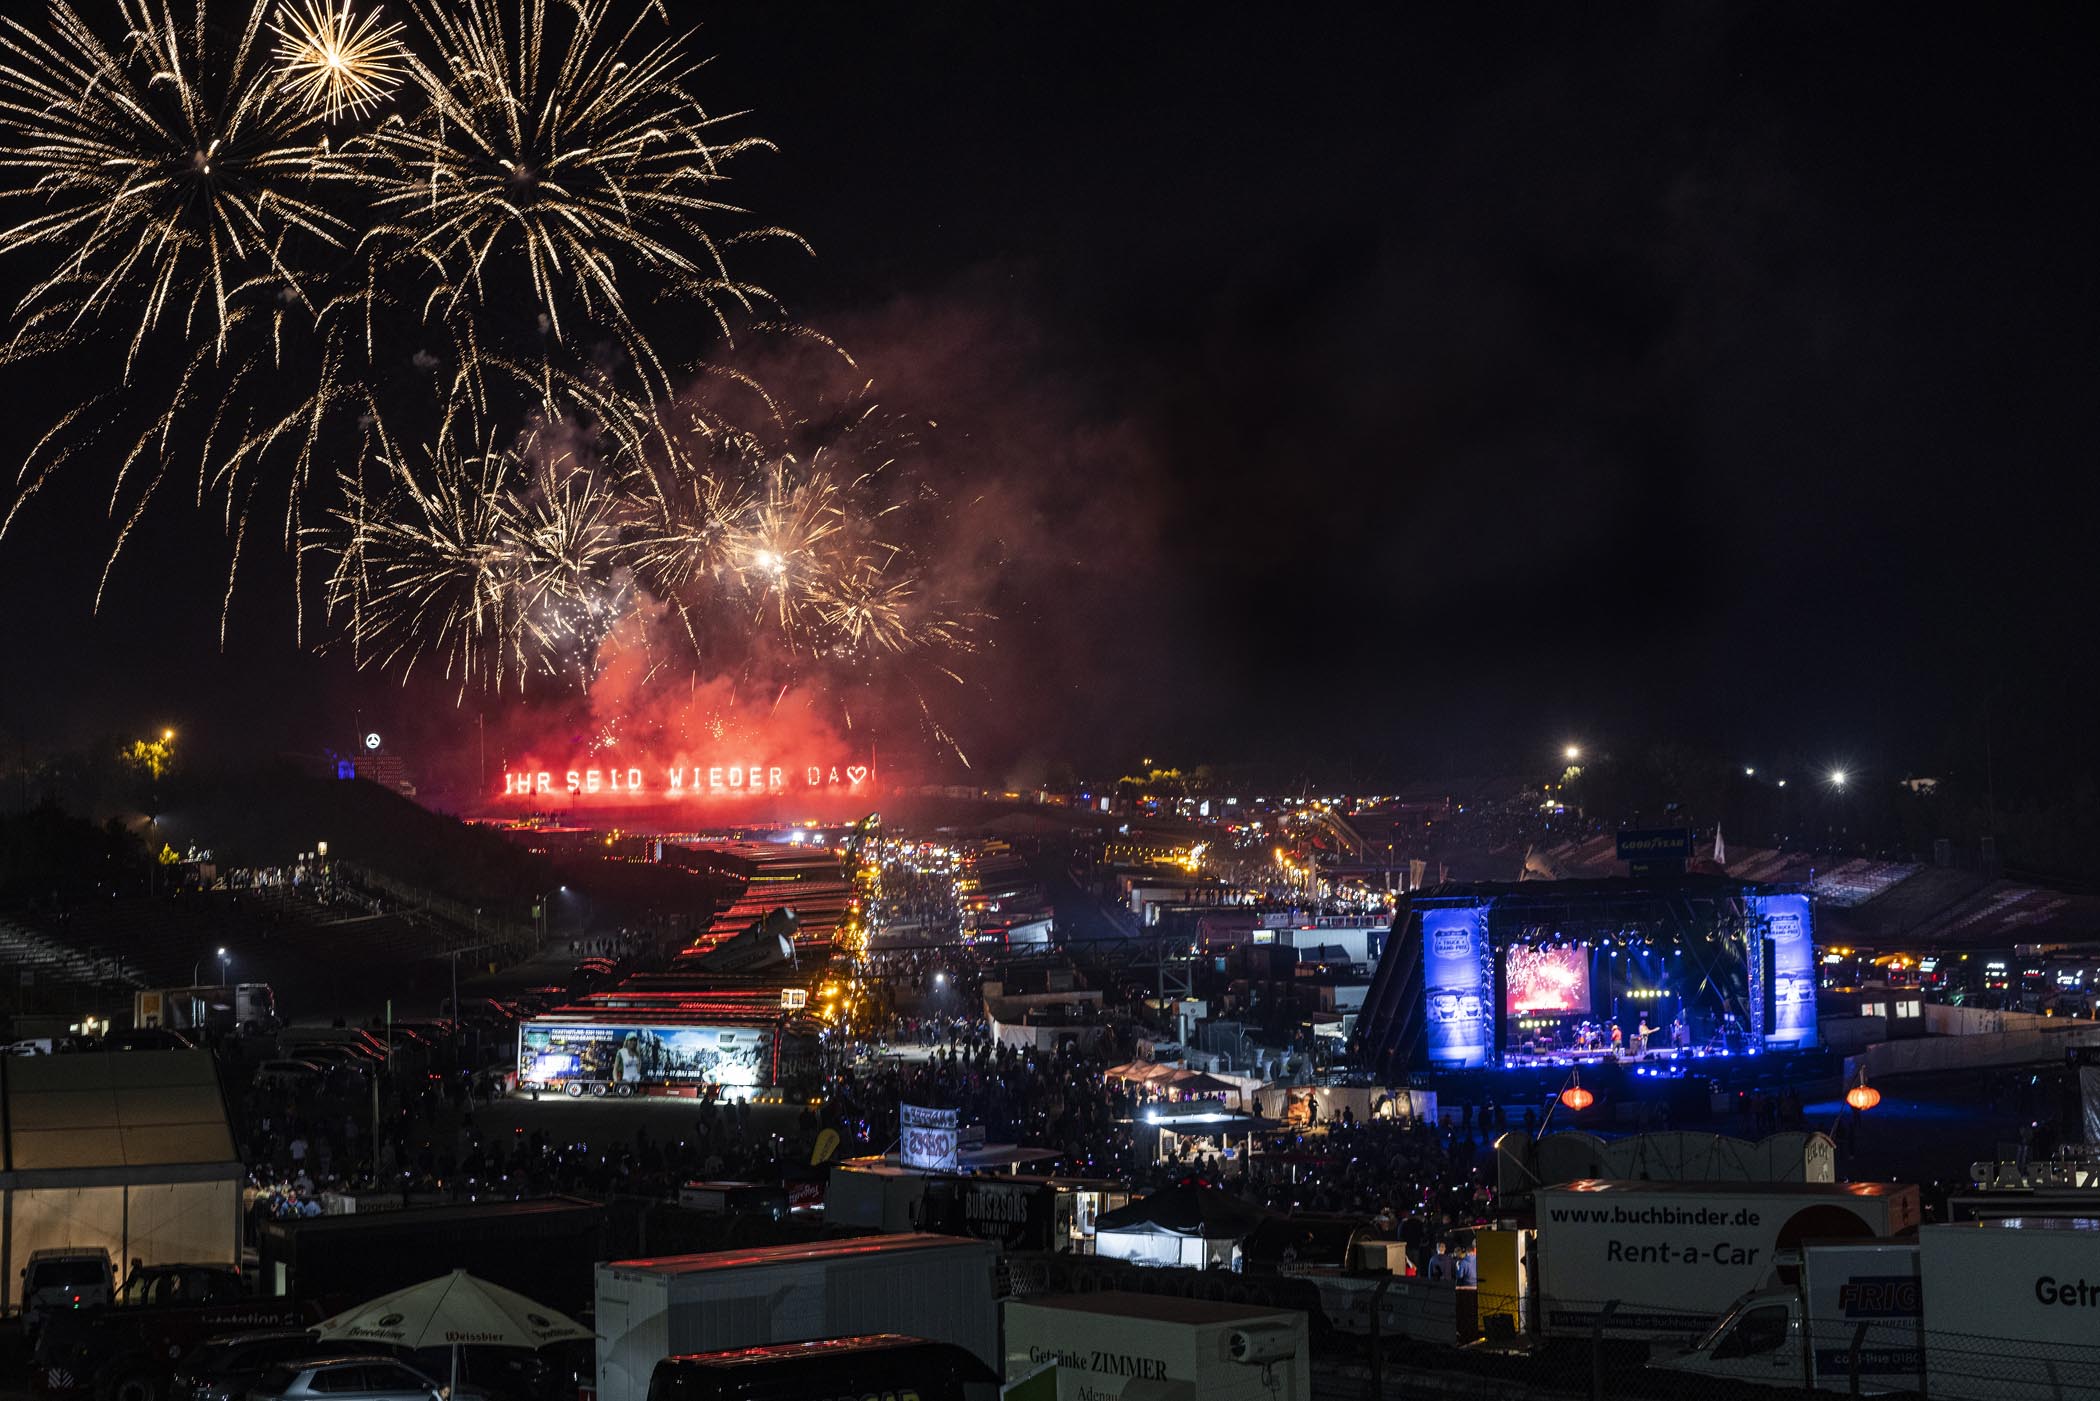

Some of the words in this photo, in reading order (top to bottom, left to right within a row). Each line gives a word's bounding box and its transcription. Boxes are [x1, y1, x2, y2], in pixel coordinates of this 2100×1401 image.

[505, 772, 551, 794] IHR
[566, 768, 641, 793] SEID
[669, 767, 783, 788] WIEDER
[808, 766, 839, 785] DA
[1622, 837, 1684, 849] GOODYEAR
[965, 1191, 1028, 1223] BUNS&SONS
[1551, 1206, 1760, 1226] www.buchbinder.de
[1608, 1240, 1759, 1265] Rent-a-Car
[2035, 1276, 2100, 1307] Getr
[445, 1331, 504, 1341] Weissbier
[1029, 1345, 1087, 1370] Getränke
[1091, 1351, 1168, 1382] ZIMMER
